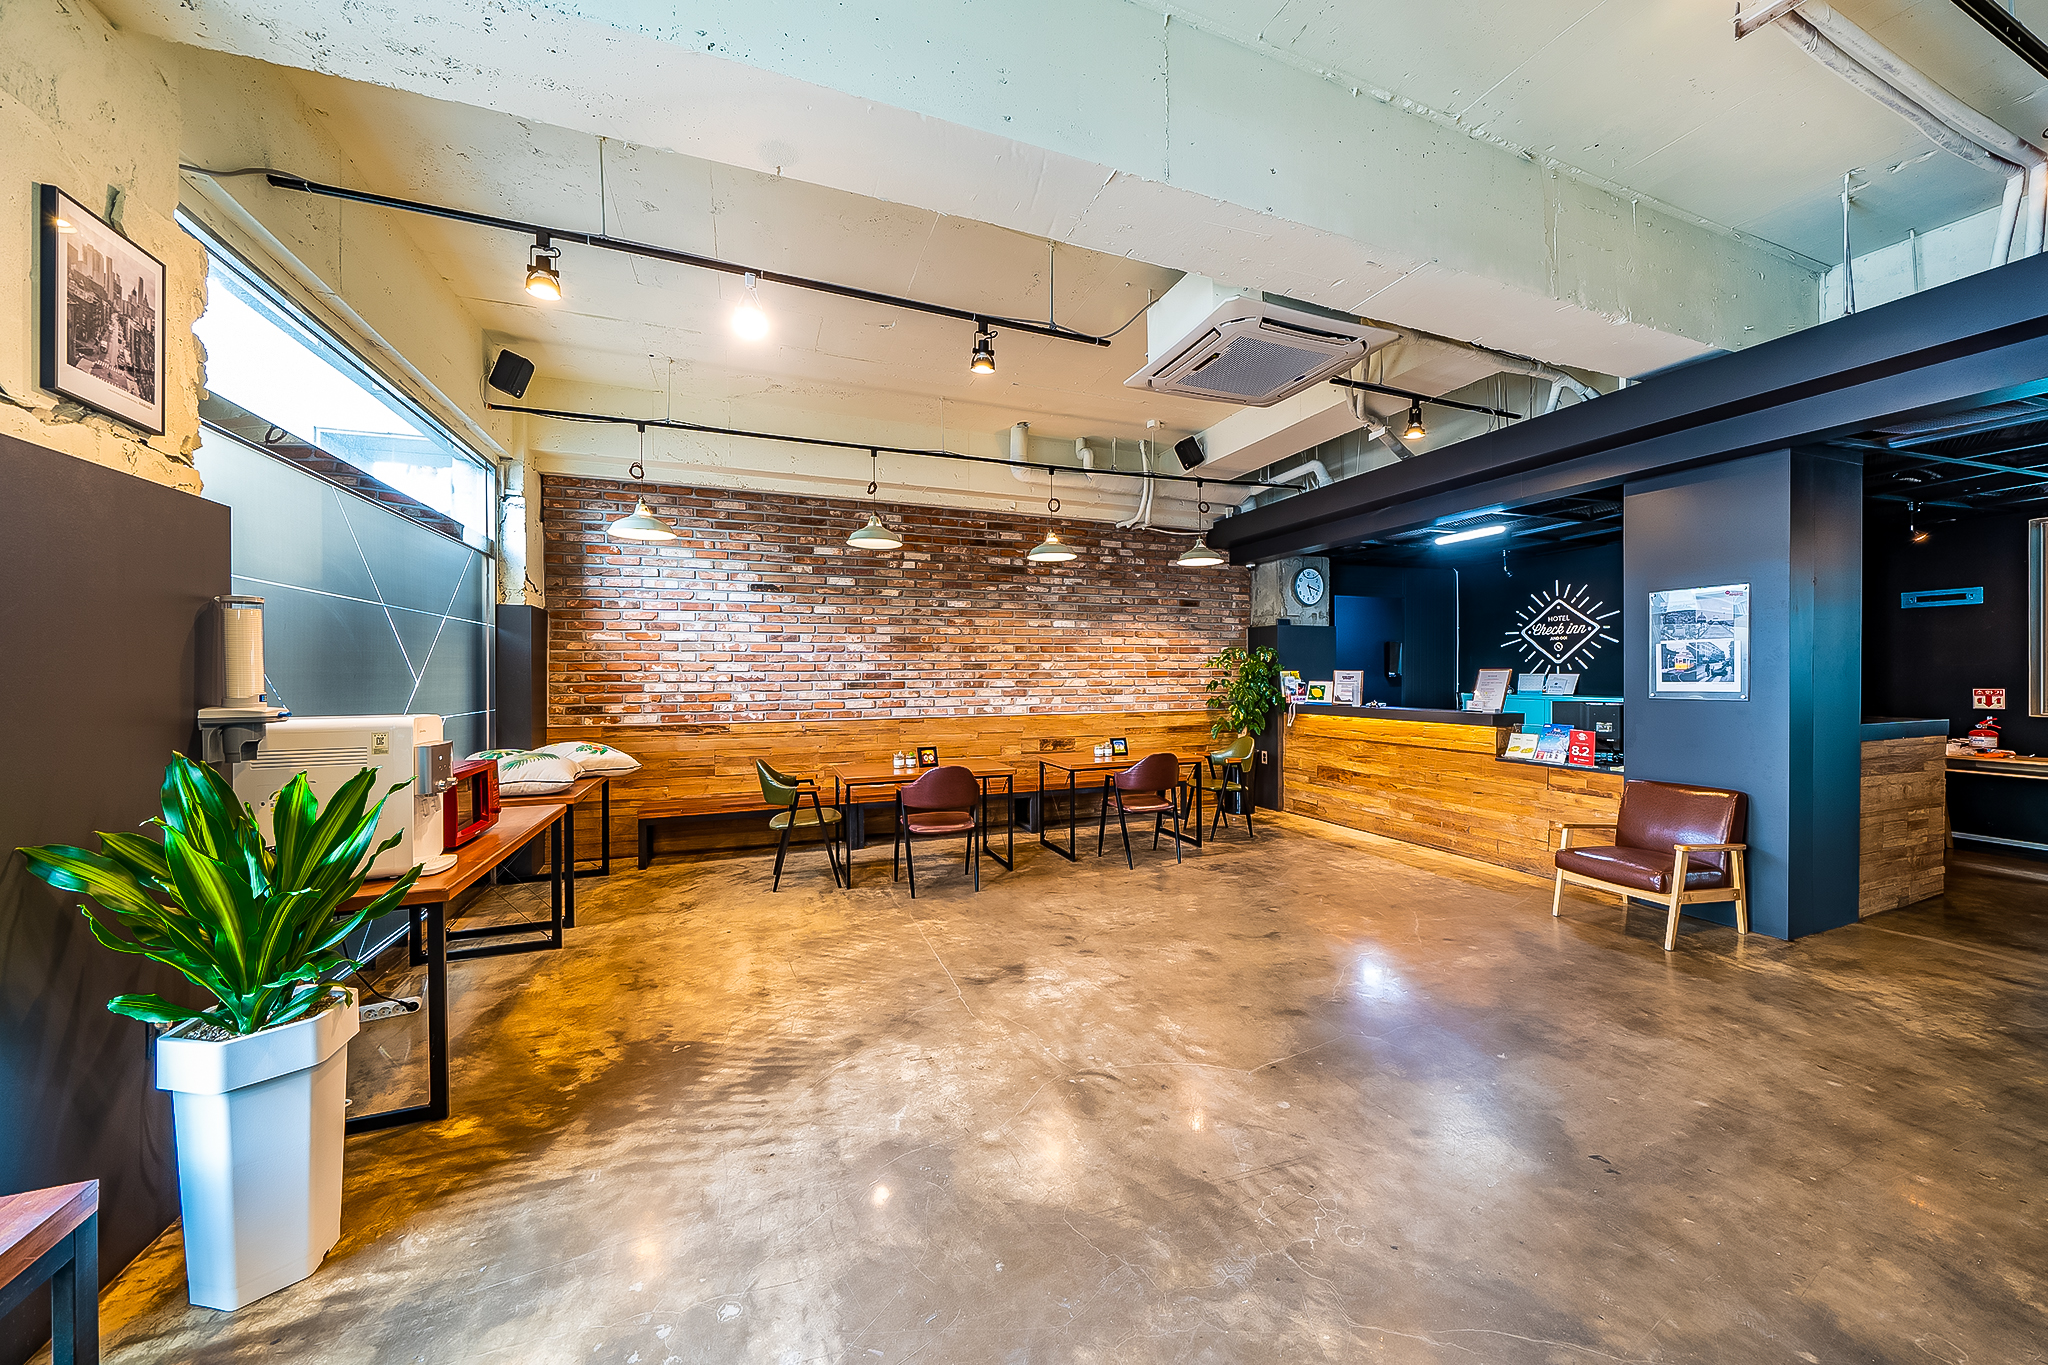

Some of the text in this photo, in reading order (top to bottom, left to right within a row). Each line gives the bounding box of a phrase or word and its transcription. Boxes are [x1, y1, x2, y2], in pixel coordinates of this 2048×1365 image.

[1547, 614, 1570, 622] HOTEL
[1532, 622, 1587, 636] Check inn
[1571, 745, 1590, 757] 8.2
